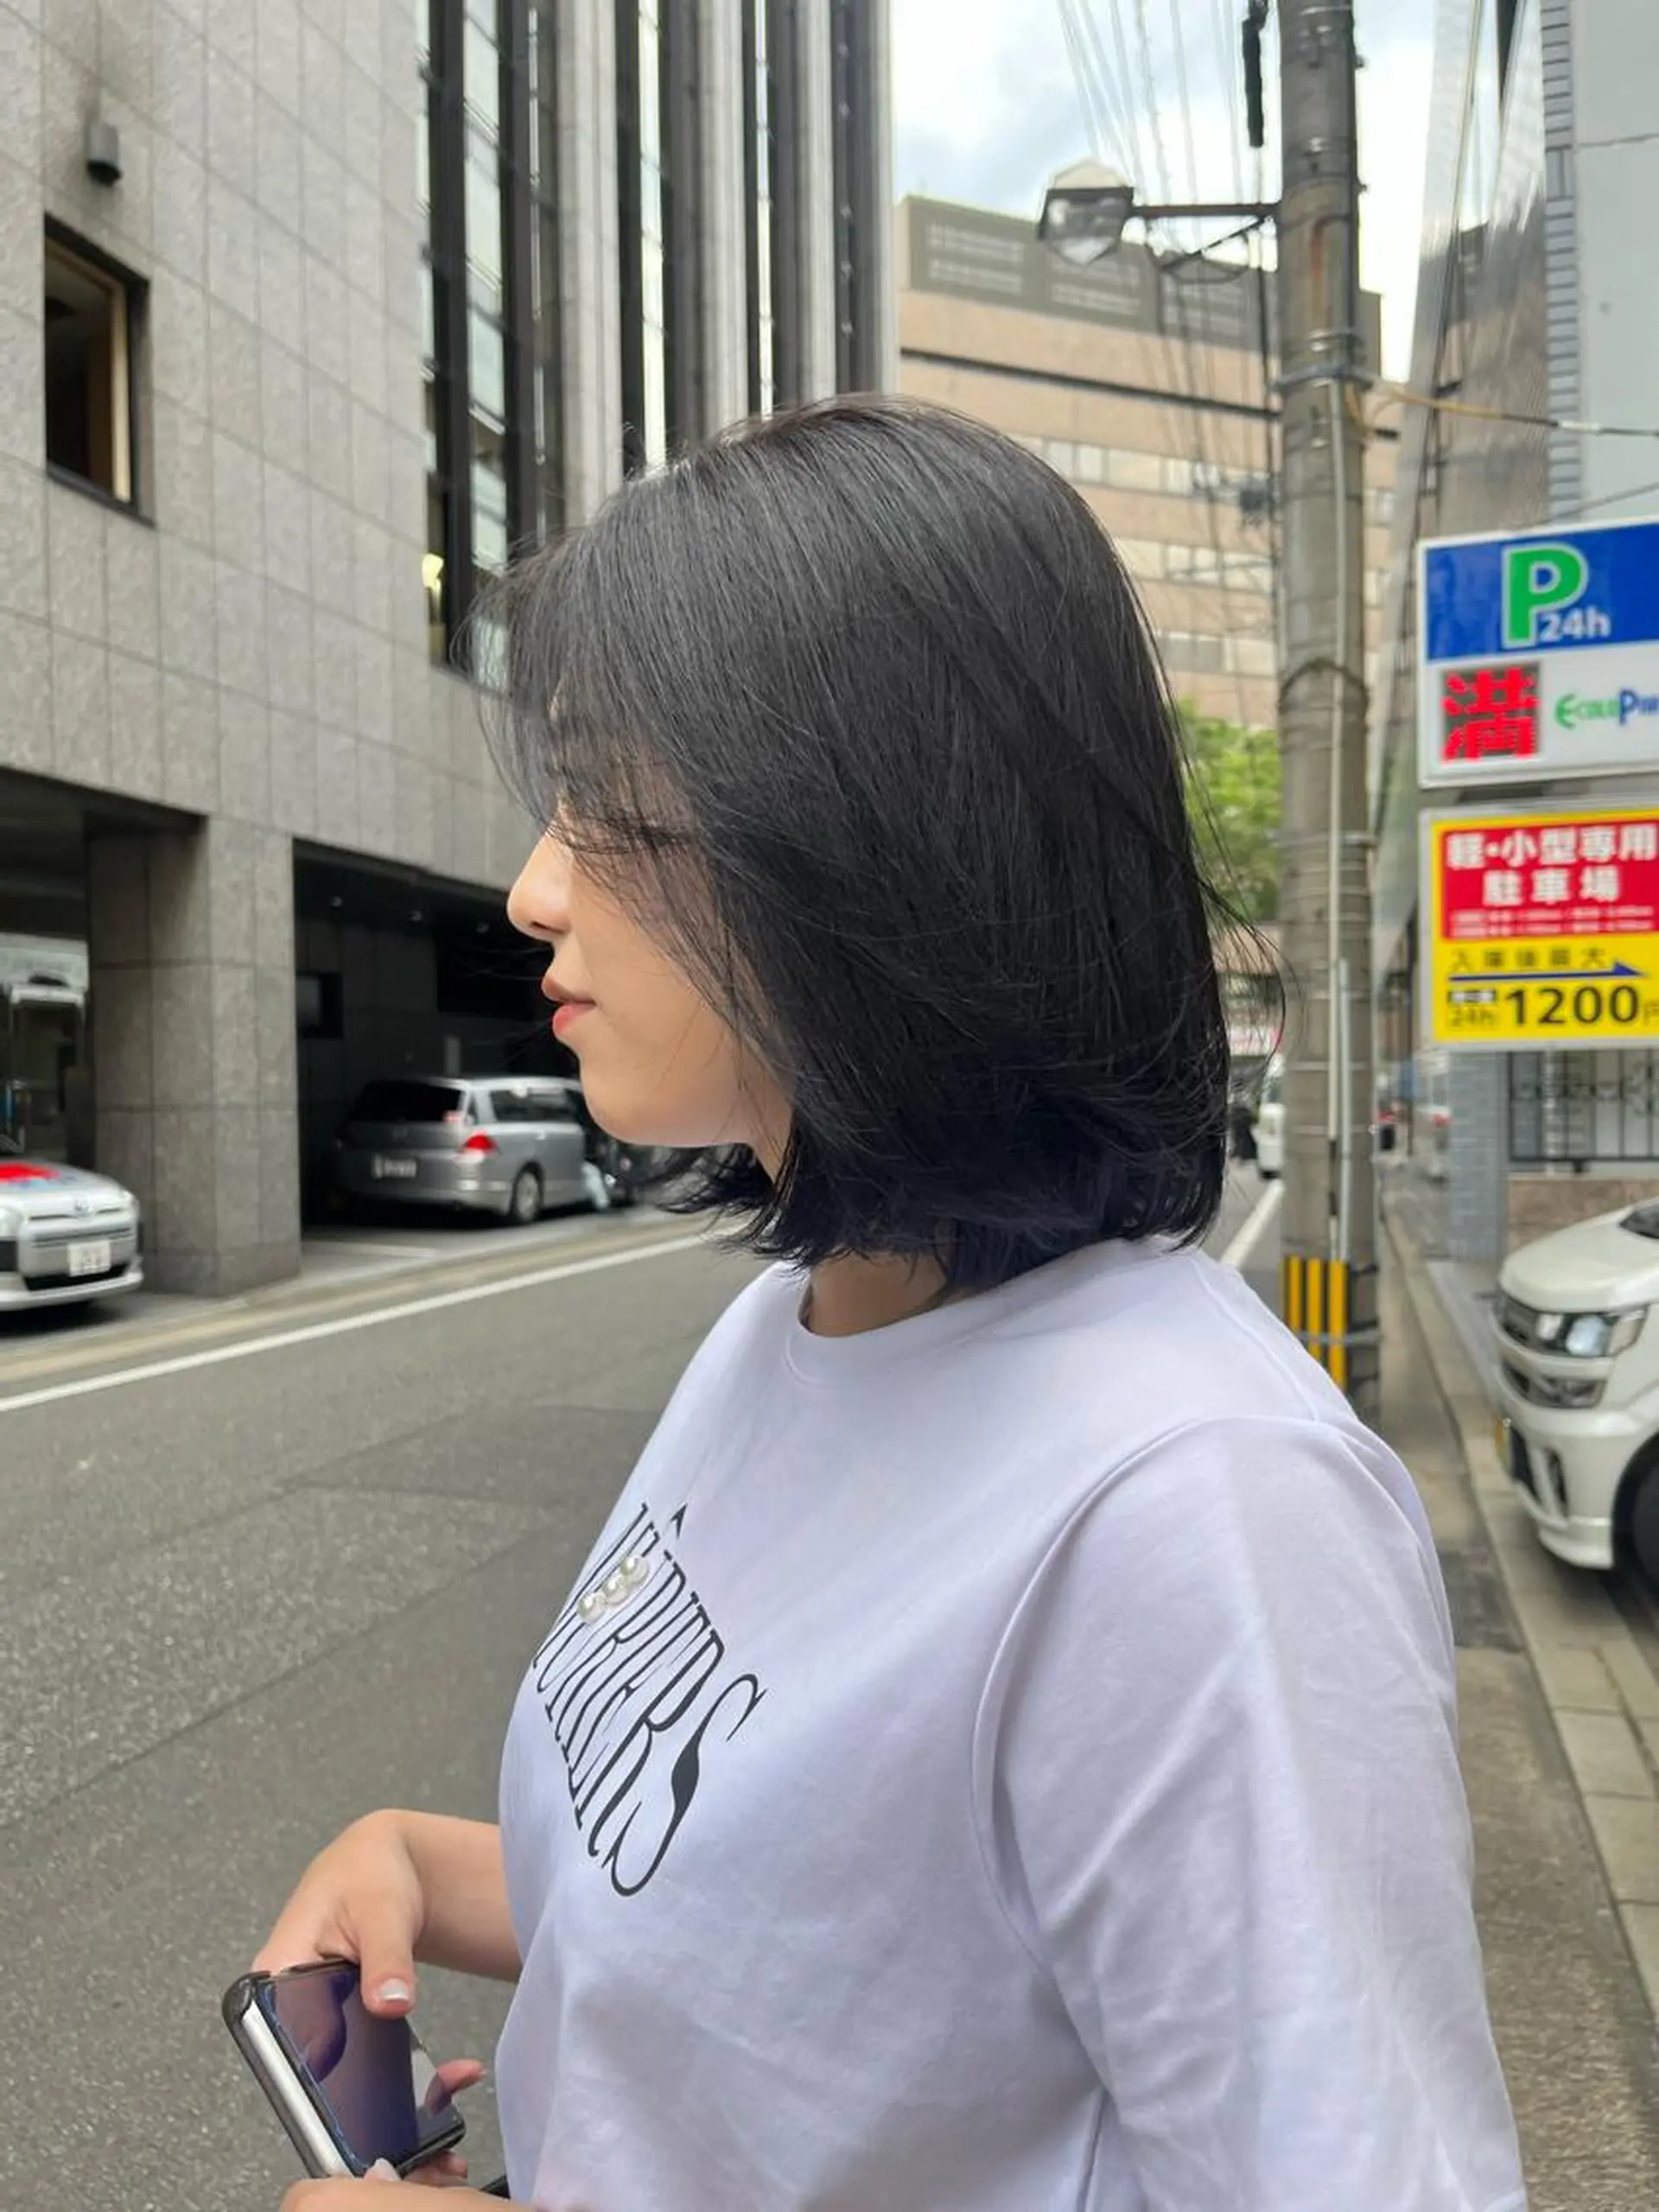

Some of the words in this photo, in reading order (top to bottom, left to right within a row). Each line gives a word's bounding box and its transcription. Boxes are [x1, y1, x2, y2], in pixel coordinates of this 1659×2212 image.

[1502, 542, 1589, 648] P
[1537, 606, 1612, 642] 24h
[1441, 665, 1541, 765] 満
[1482, 865, 1621, 907] 駐車場
